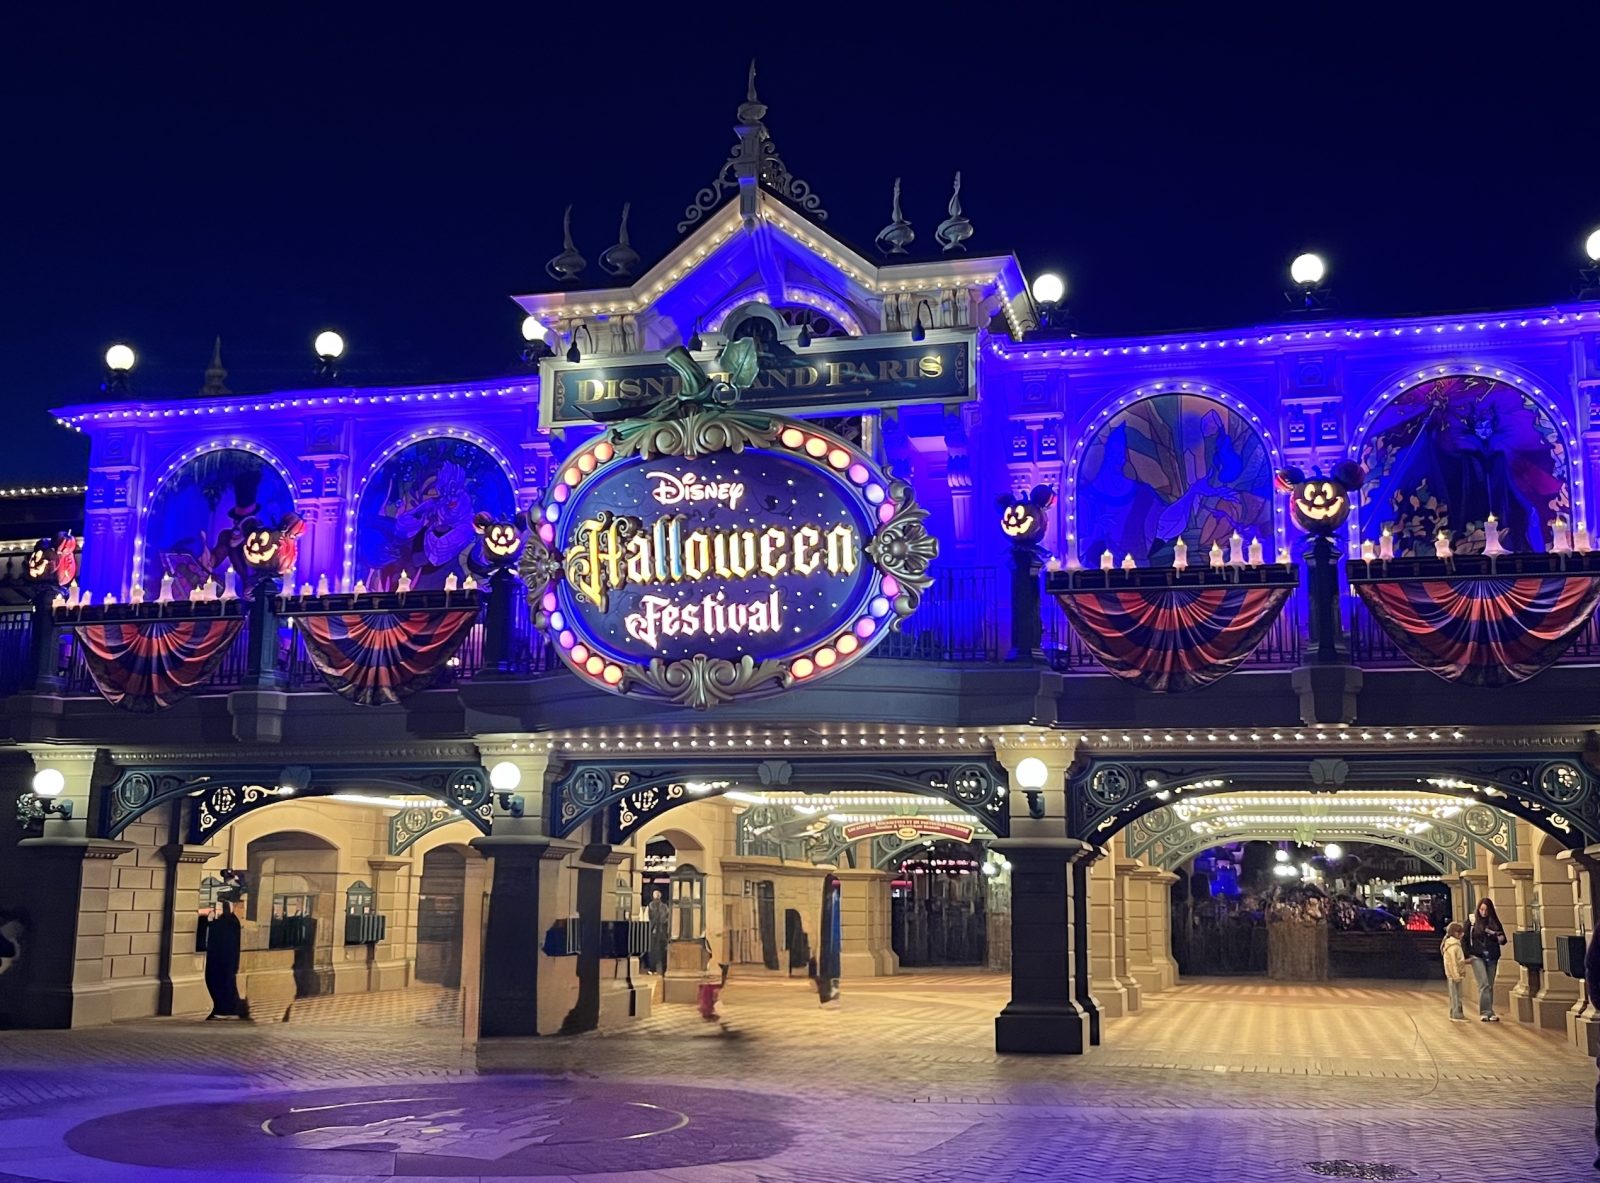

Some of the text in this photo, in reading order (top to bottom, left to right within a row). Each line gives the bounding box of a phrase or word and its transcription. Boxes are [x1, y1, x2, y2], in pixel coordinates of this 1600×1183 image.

[825, 356, 943, 387] PARIS
[565, 511, 858, 613] Halloween
[624, 590, 782, 649] Festival
